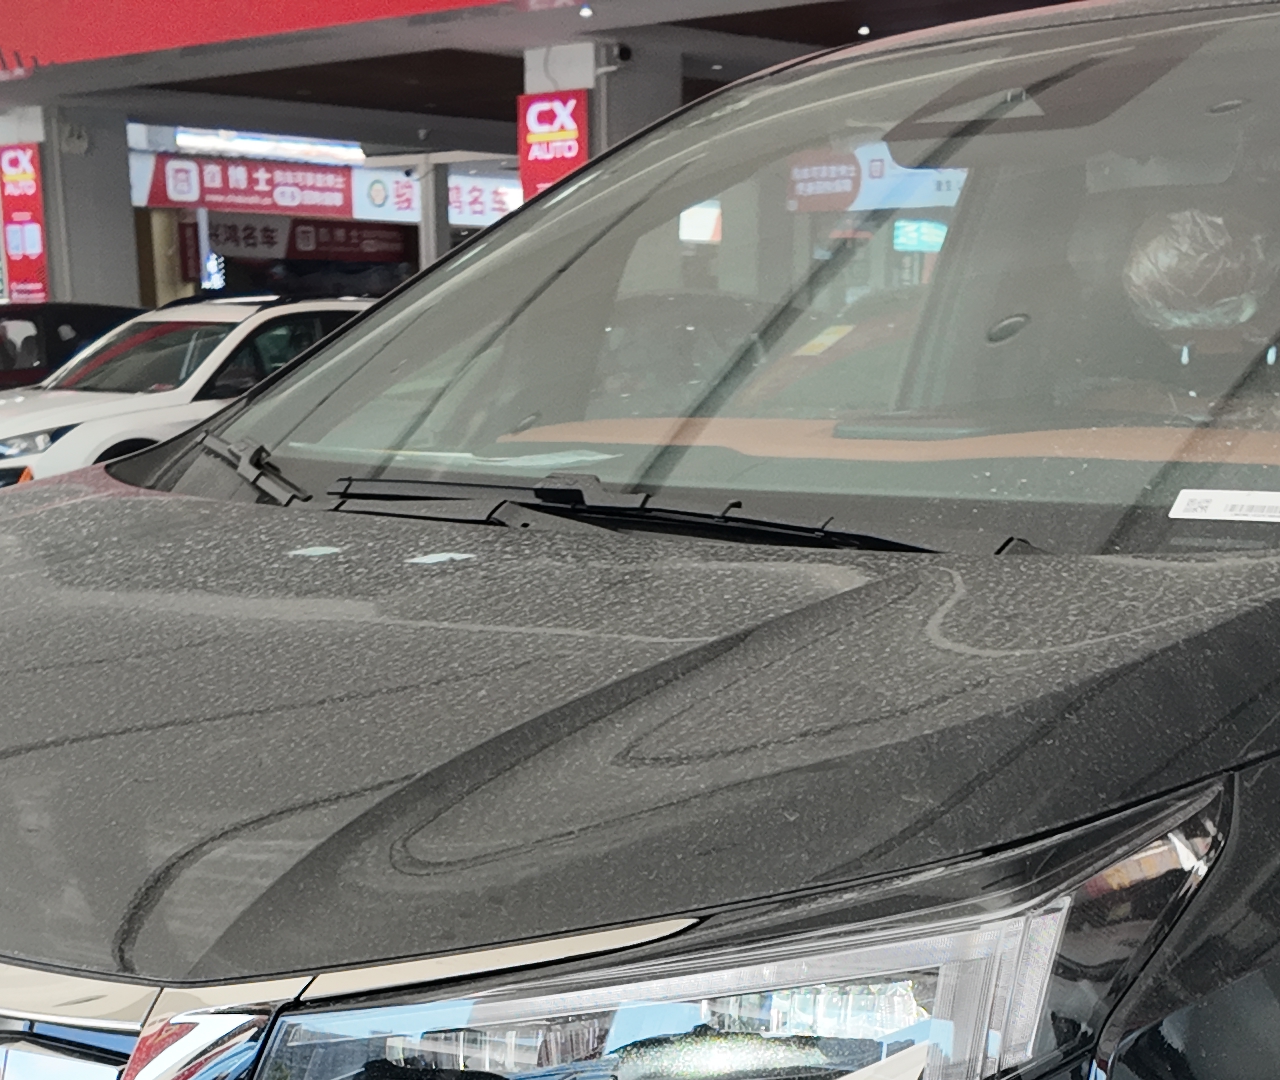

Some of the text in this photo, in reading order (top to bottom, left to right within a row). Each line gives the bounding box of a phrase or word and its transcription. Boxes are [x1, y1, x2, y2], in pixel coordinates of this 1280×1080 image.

[526, 98, 577, 133] CX
[528, 140, 578, 160] AUTO
[1, 150, 34, 174] CX
[4, 180, 36, 196] AUTO
